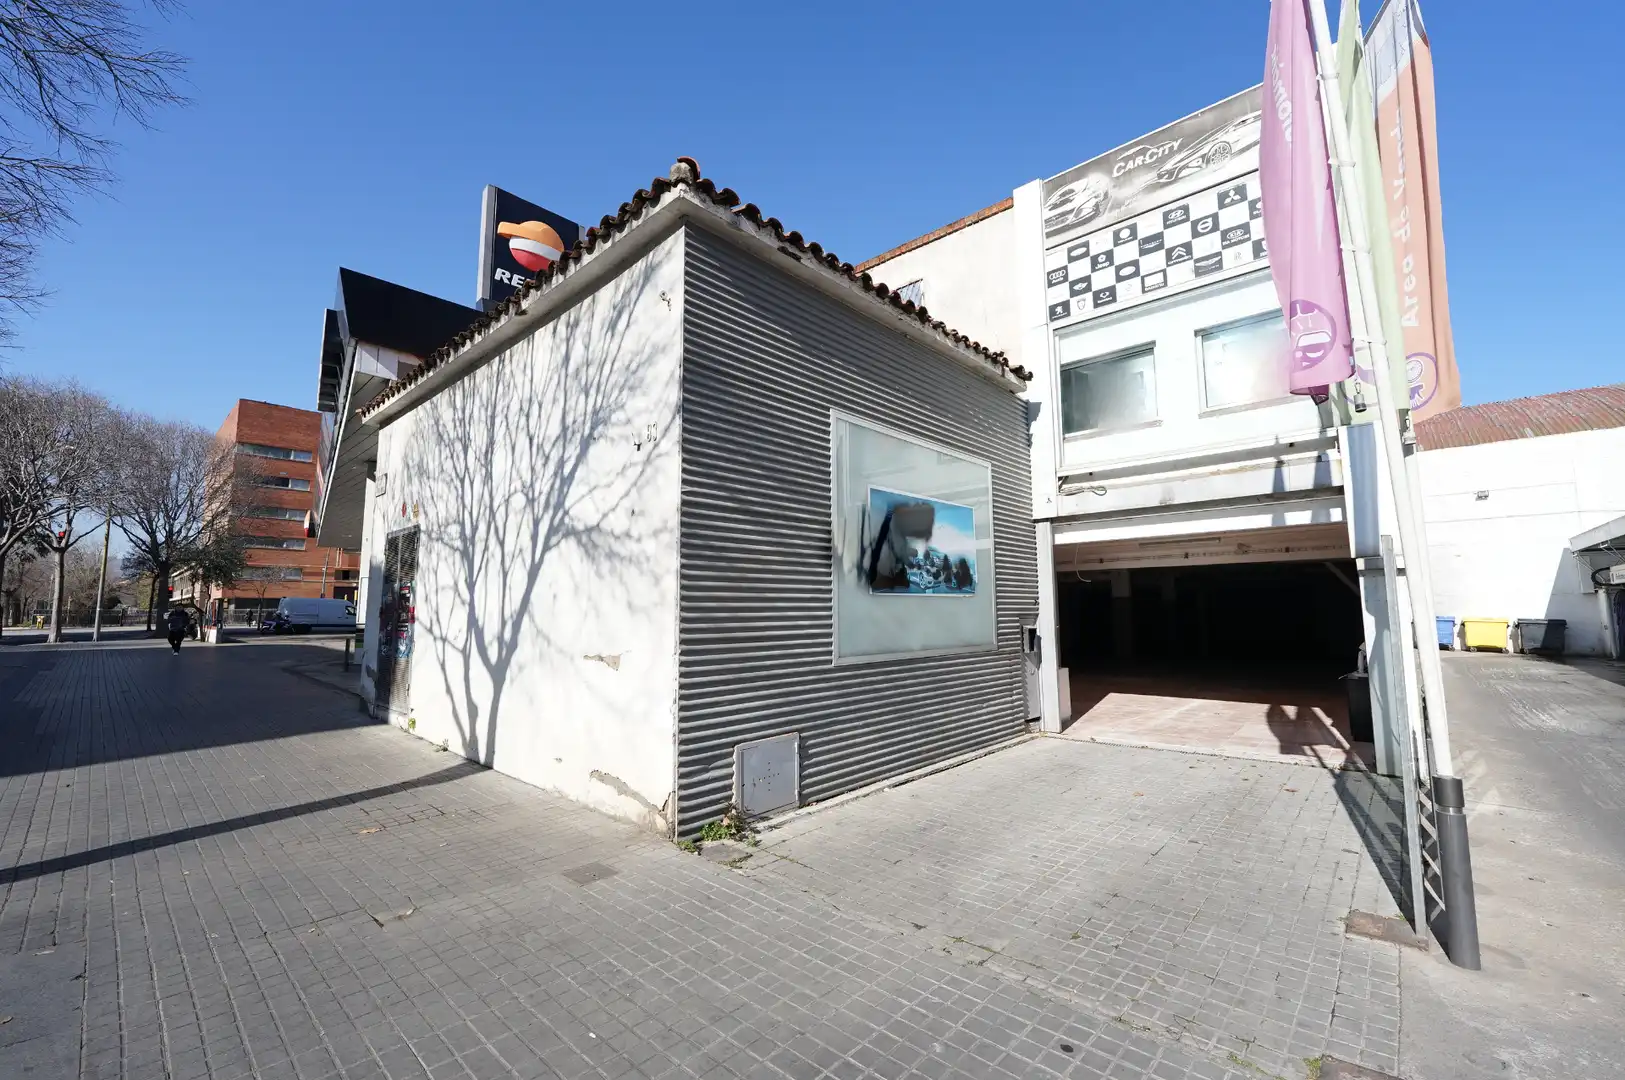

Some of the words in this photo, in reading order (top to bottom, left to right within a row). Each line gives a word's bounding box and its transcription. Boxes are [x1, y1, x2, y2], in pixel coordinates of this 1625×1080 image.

[1393, 204, 1411, 242] de
[494, 267, 529, 289] RE
[1401, 253, 1420, 327] Area
